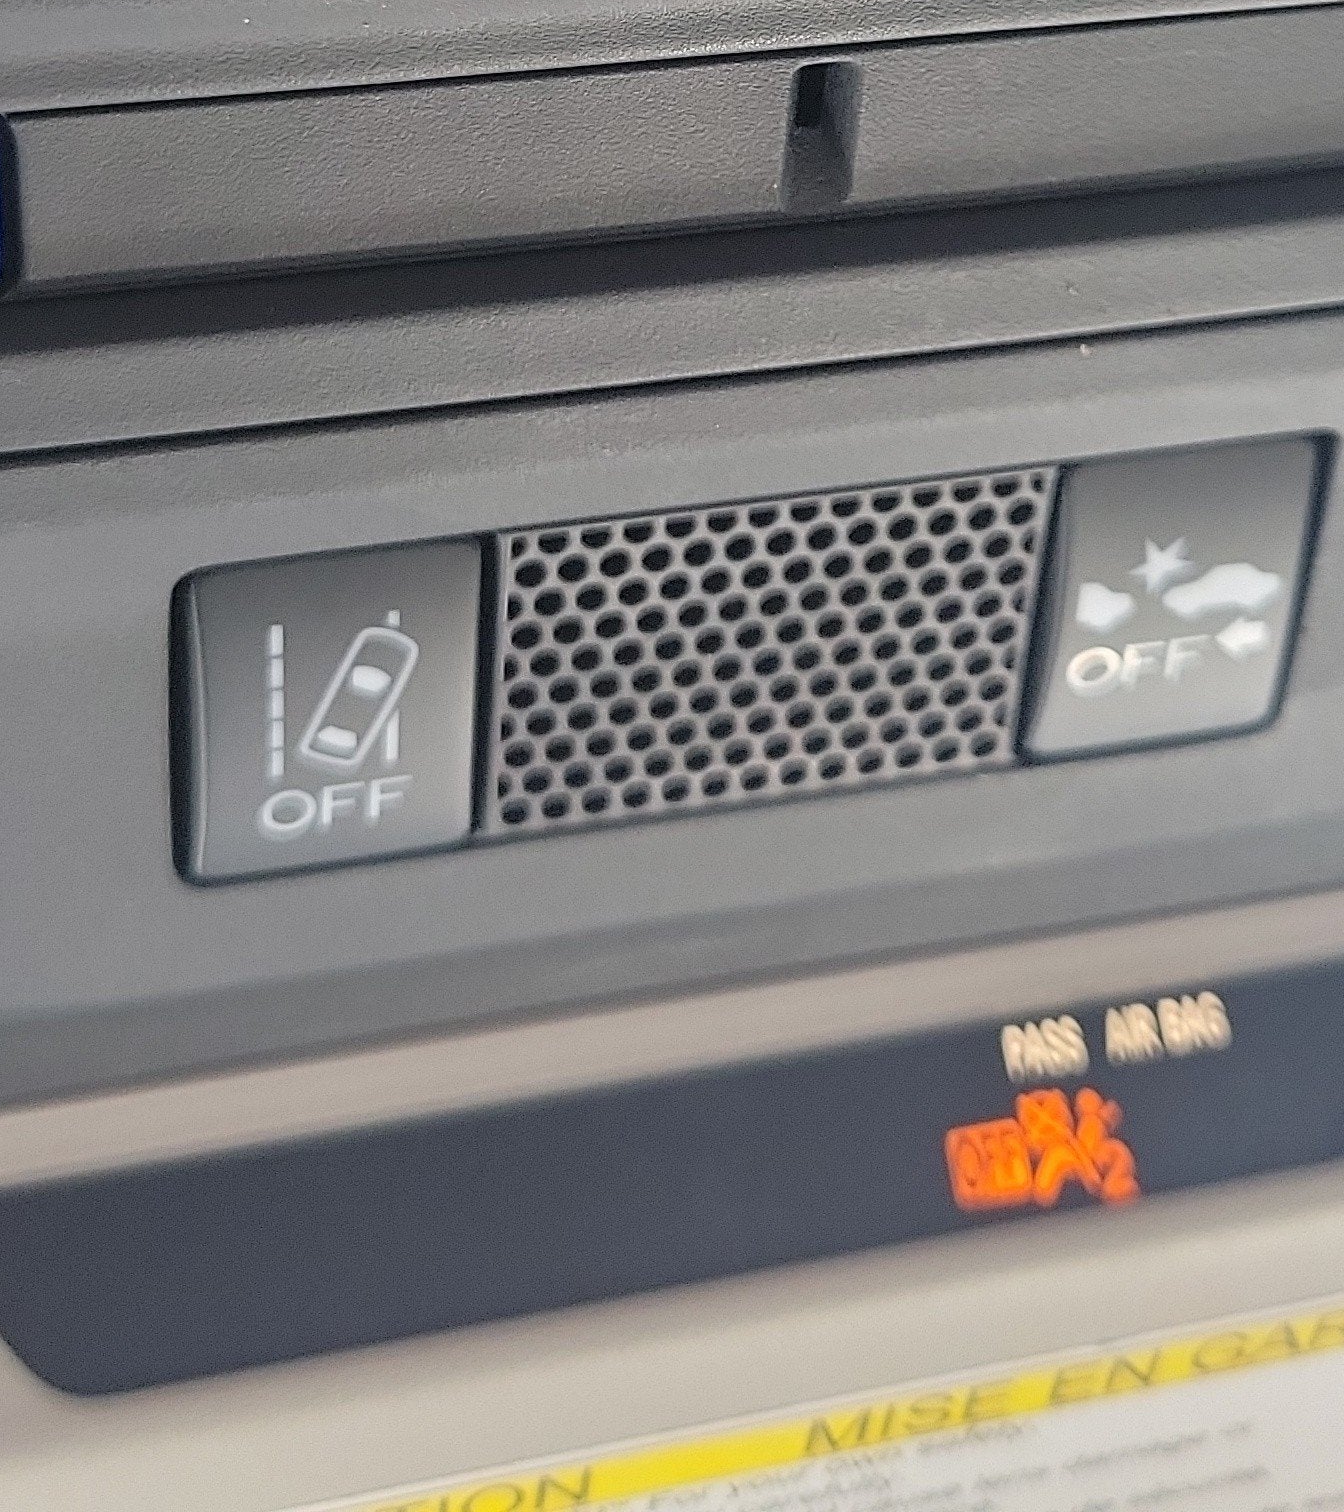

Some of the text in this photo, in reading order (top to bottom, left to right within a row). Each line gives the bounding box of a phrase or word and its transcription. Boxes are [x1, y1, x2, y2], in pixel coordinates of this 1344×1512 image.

[1065, 632, 1214, 694] OFF
[260, 772, 413, 840] OFF
[1001, 1013, 1090, 1084] PASS
[1105, 1001, 1163, 1067] AIR
[803, 1377, 1014, 1457] MISE
[1048, 1352, 1163, 1409] EN
